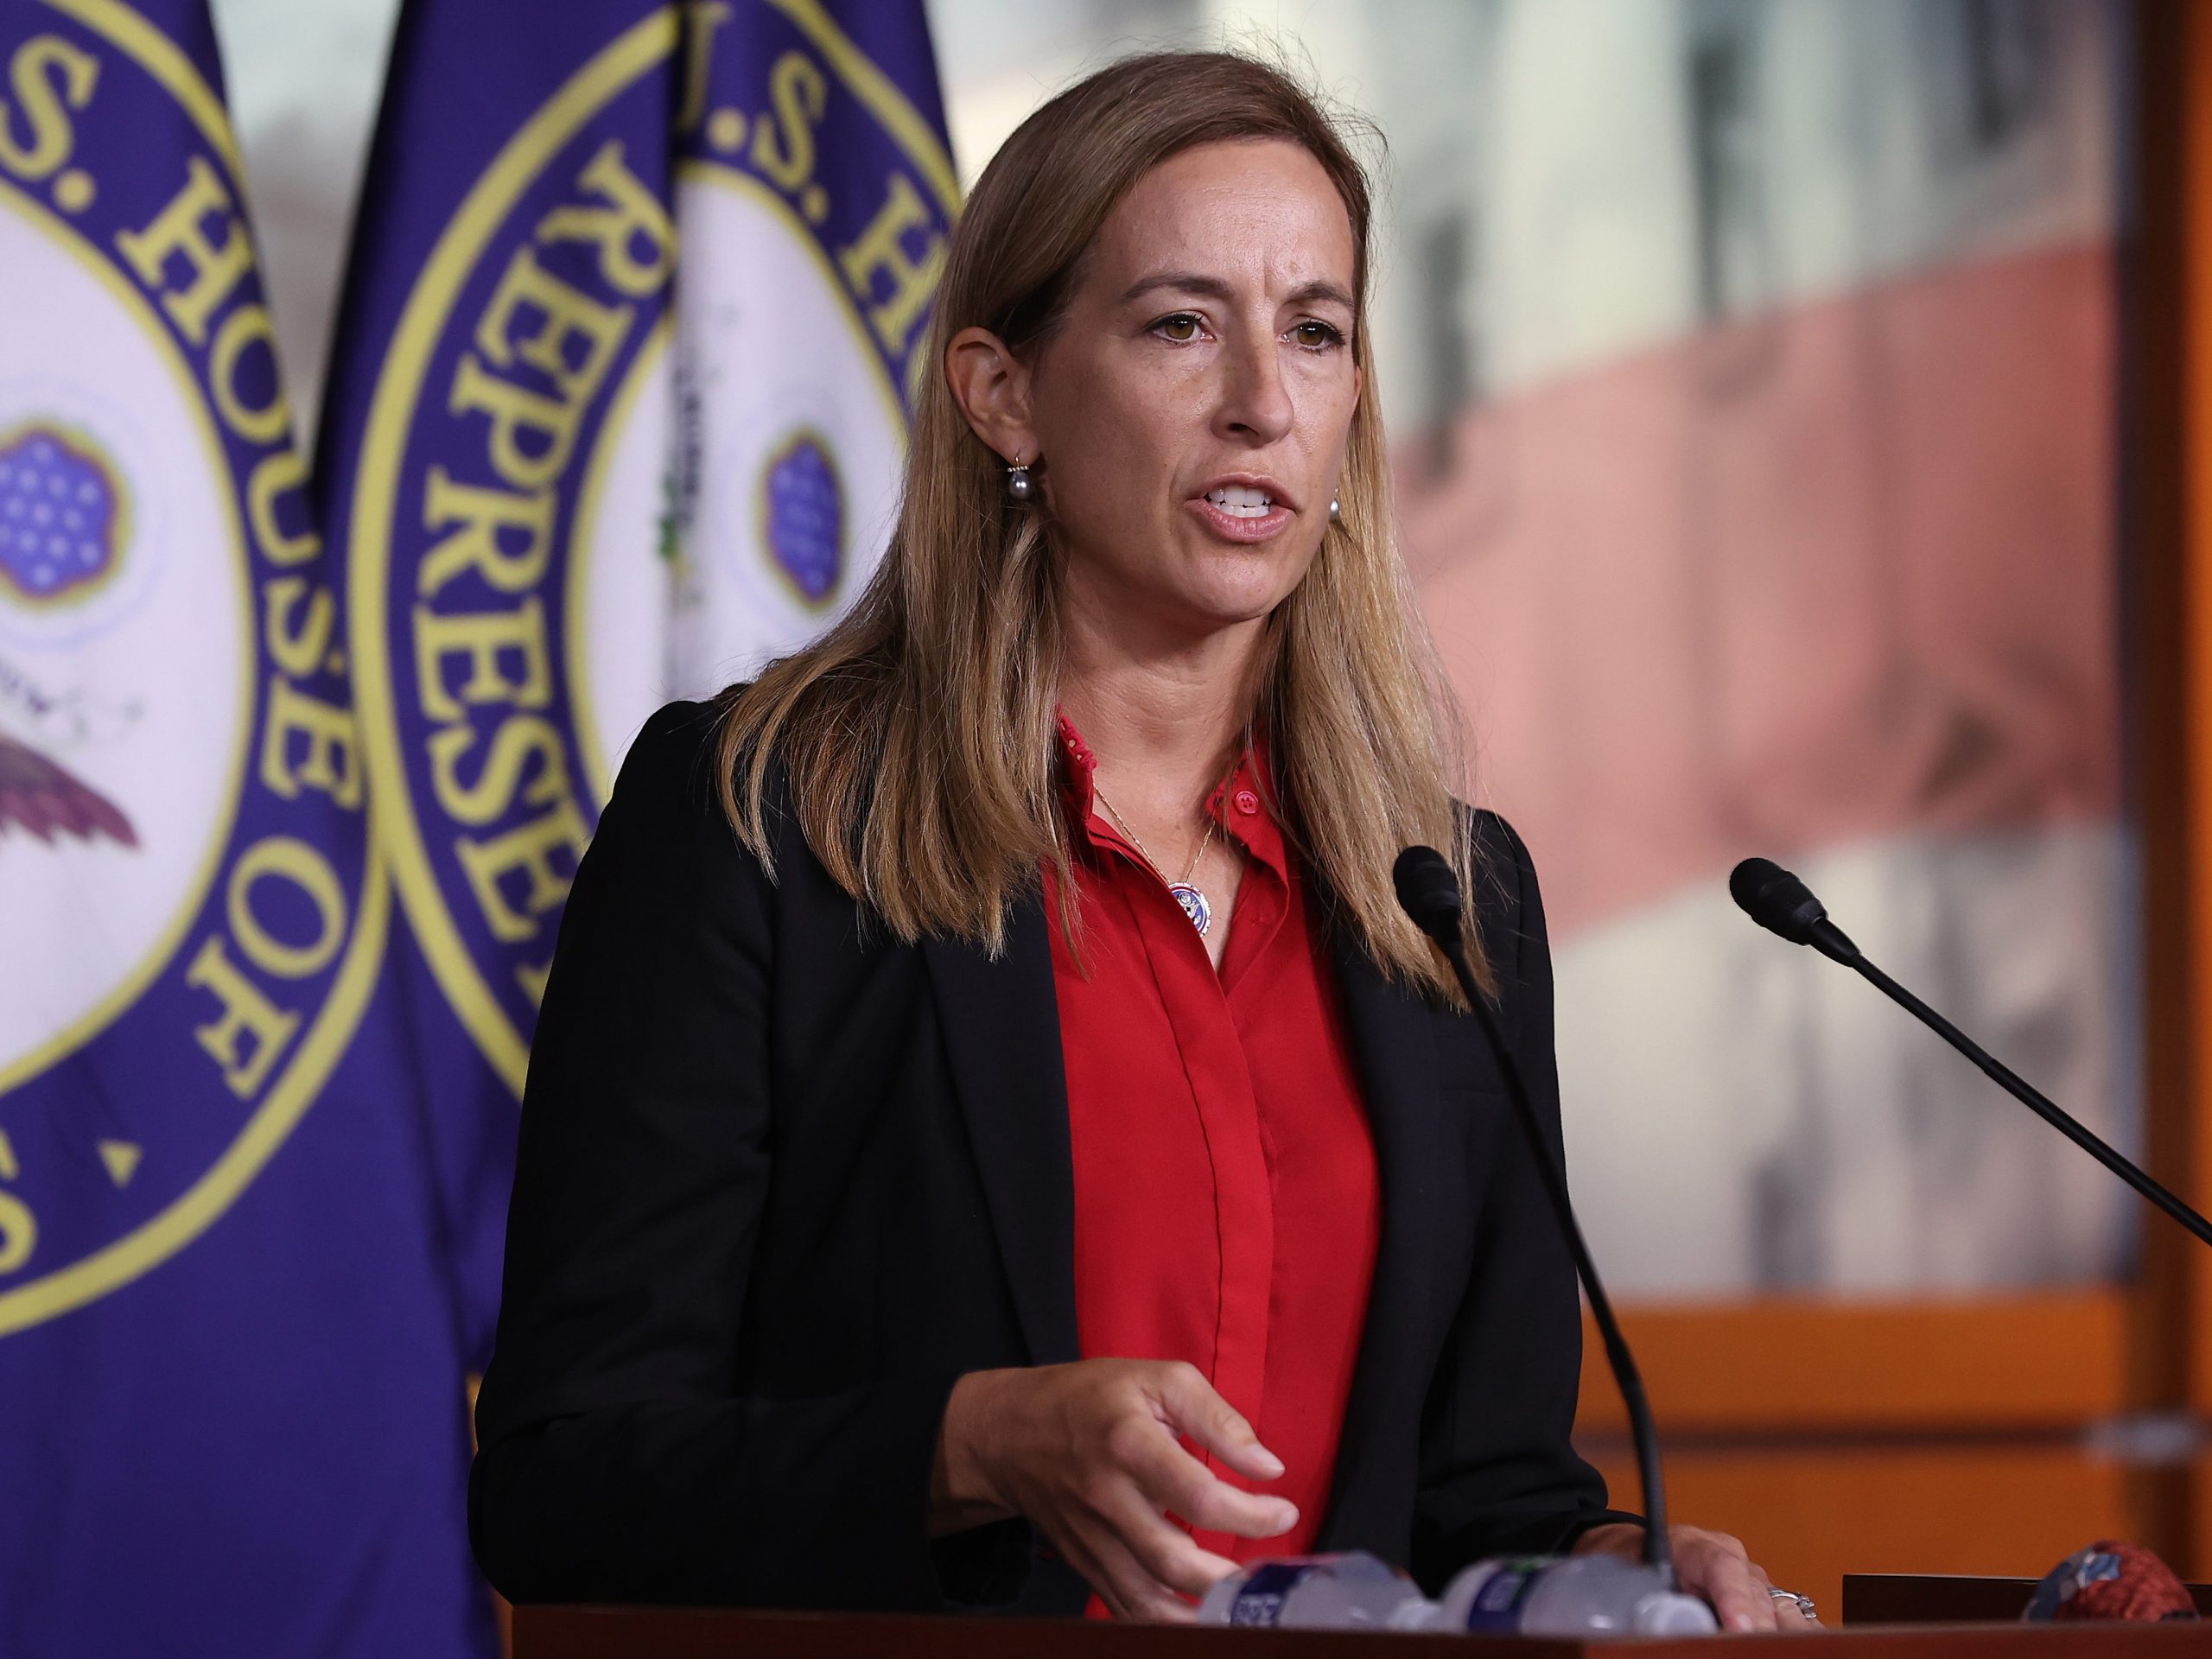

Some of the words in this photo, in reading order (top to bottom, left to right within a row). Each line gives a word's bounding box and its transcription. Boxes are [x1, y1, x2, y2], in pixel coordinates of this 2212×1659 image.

[115, 156, 363, 809] HOUSE
[411, 138, 678, 1011] REPRESE
[184, 836, 344, 1101] OF
